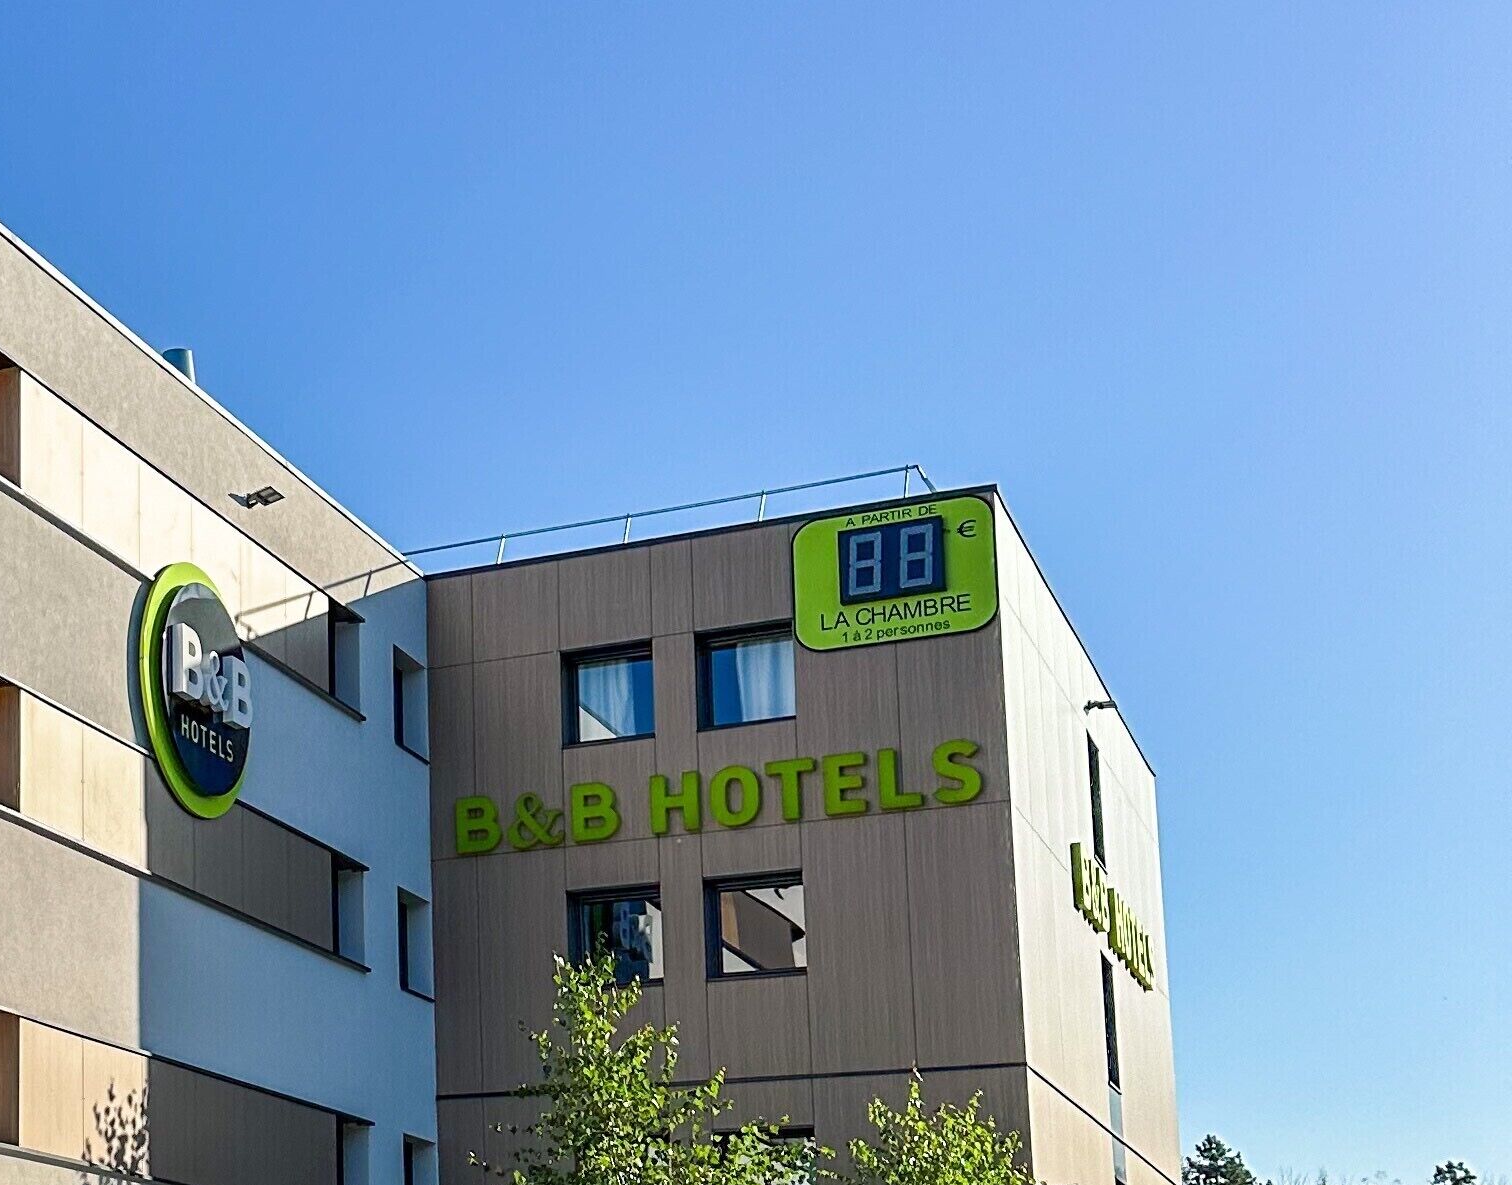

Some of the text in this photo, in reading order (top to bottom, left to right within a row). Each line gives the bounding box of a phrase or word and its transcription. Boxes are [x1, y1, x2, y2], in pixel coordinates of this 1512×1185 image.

[845, 504, 937, 527] A PARTIR DE
[821, 594, 971, 631] LA CHAMBRE
[842, 632, 848, 643] 1
[865, 628, 873, 639] 2
[877, 620, 951, 639] personnes
[166, 622, 252, 730] B&B
[181, 713, 235, 763] HOTELS
[456, 739, 983, 855] B&B HOTELS
